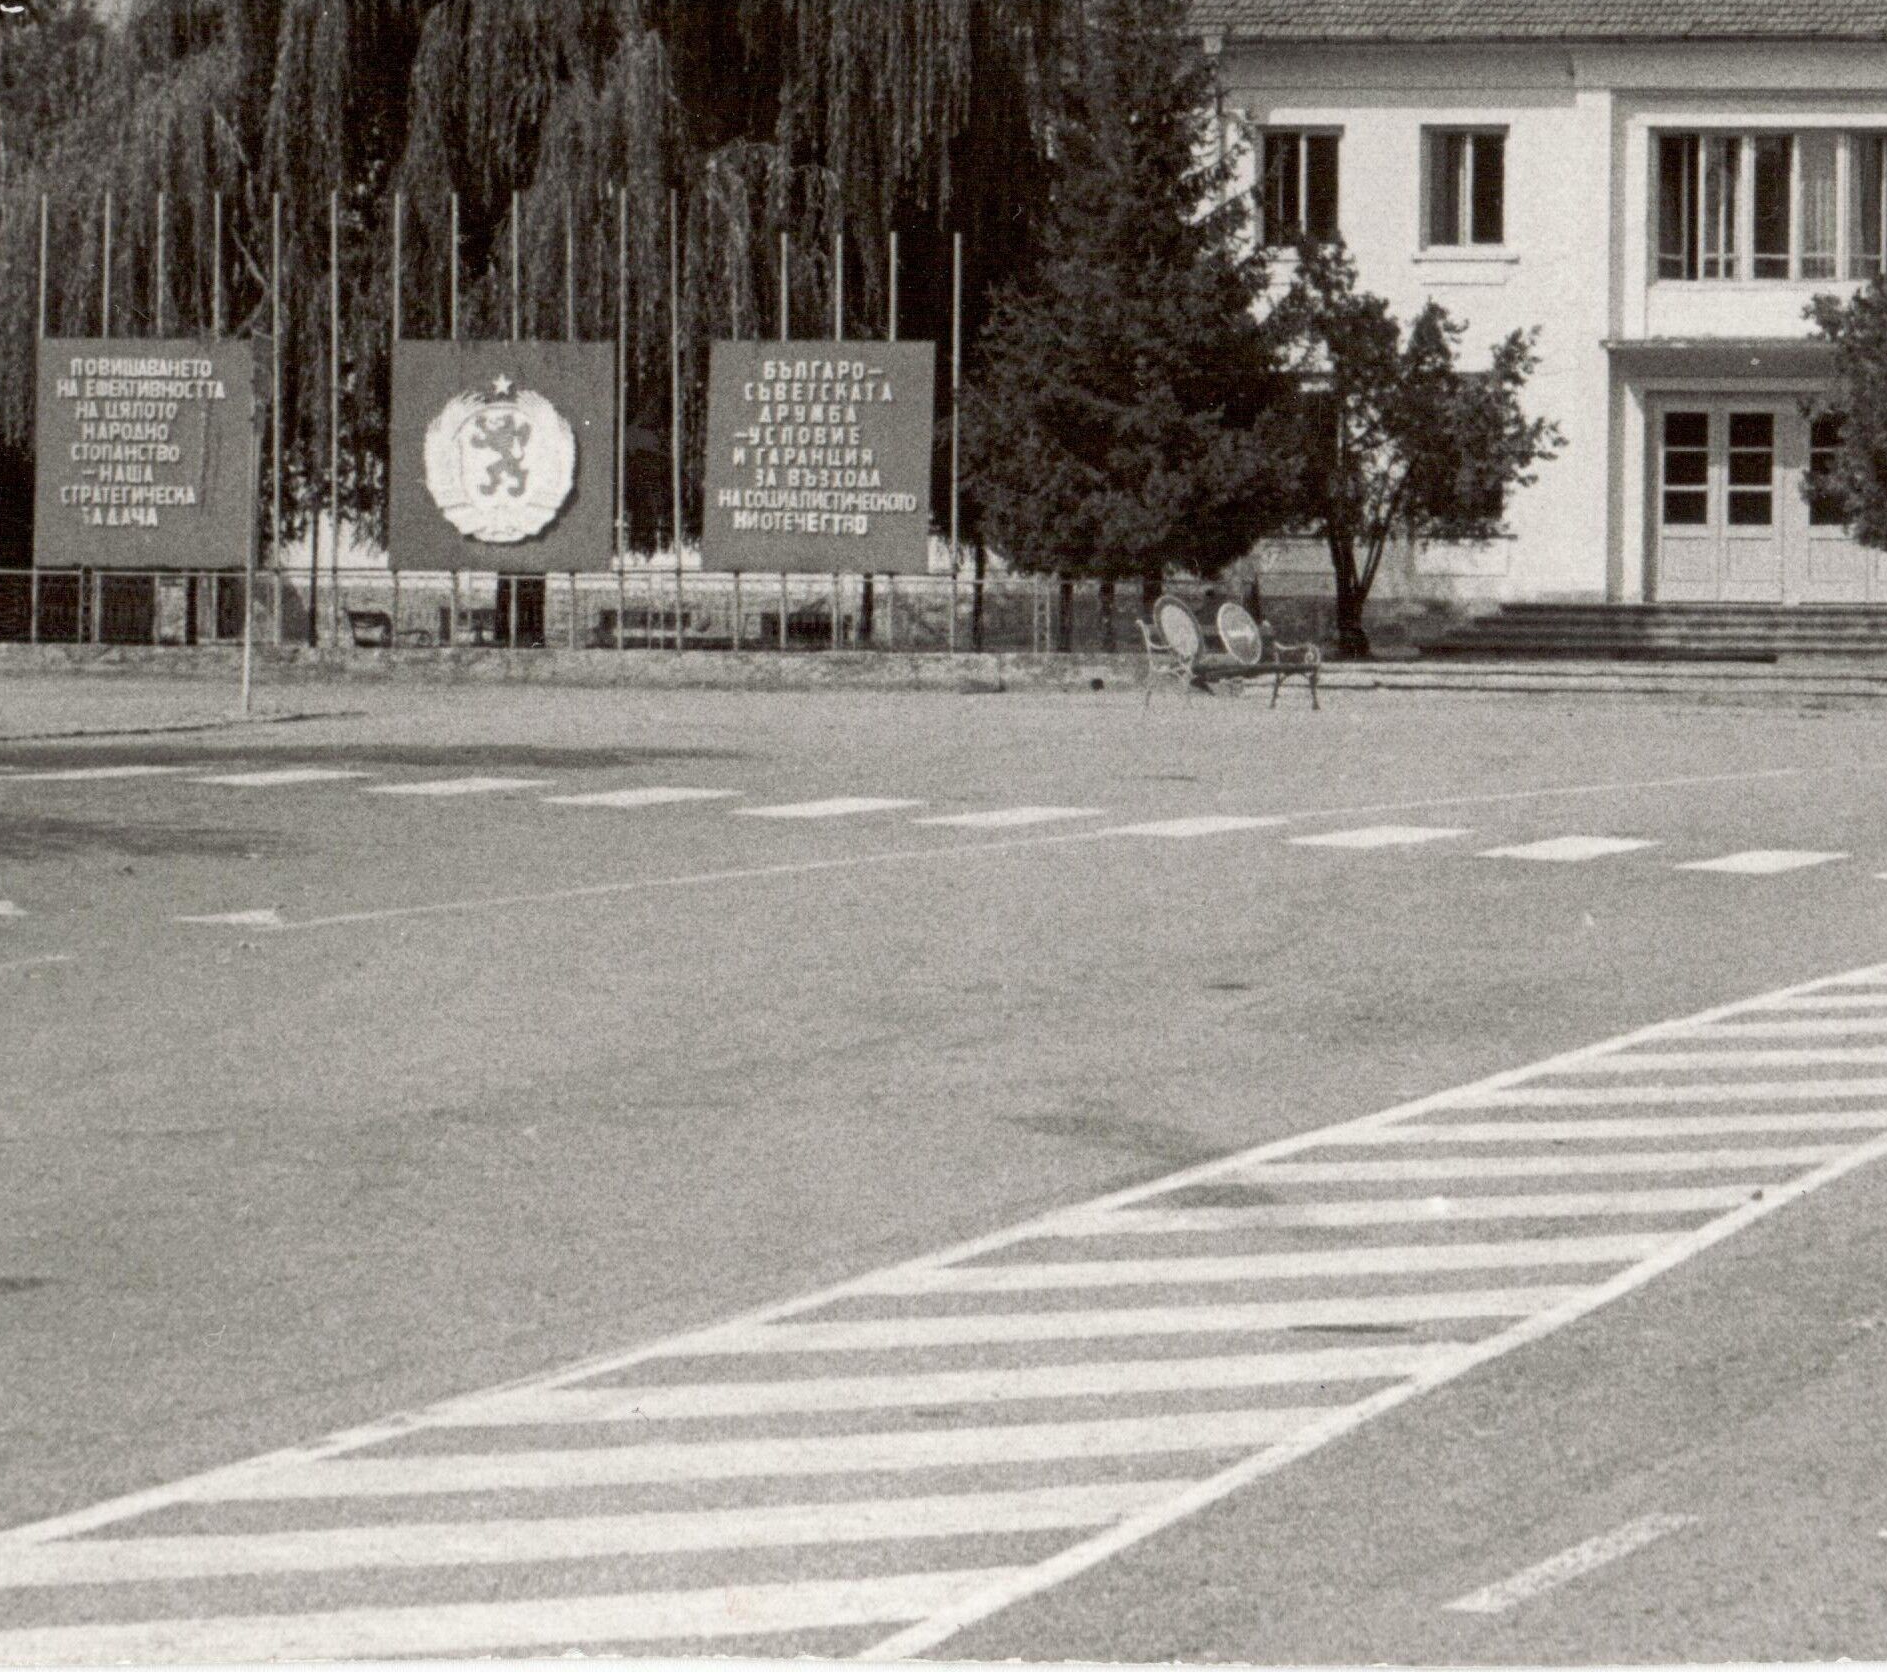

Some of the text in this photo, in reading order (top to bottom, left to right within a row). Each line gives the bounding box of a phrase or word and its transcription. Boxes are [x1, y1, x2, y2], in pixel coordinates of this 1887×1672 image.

[70, 357, 212, 377] ПОВИШАВАНЕТО
[57, 379, 226, 399] НА ЕФЕКТИВНОСТТА
[744, 382, 893, 402] СЪВЕТСКАТА
[76, 400, 178, 420] НА ЦЯЛОТО
[759, 404, 857, 424] ДРУЖБА
[81, 422, 169, 441] НАРОДНО
[70, 442, 180, 462] СТОПАНСТВО
[732, 446, 874, 467] И ГАРАНЦИЯ
[756, 467, 881, 489] ЗА ВЪЗХОДА
[60, 485, 196, 505] СТРАТЕГИЧЕСКА
[718, 489, 916, 512] НА СОЦИАЛИСТИЧЕСКОТО
[82, 506, 158, 527] ЗАДАЧА
